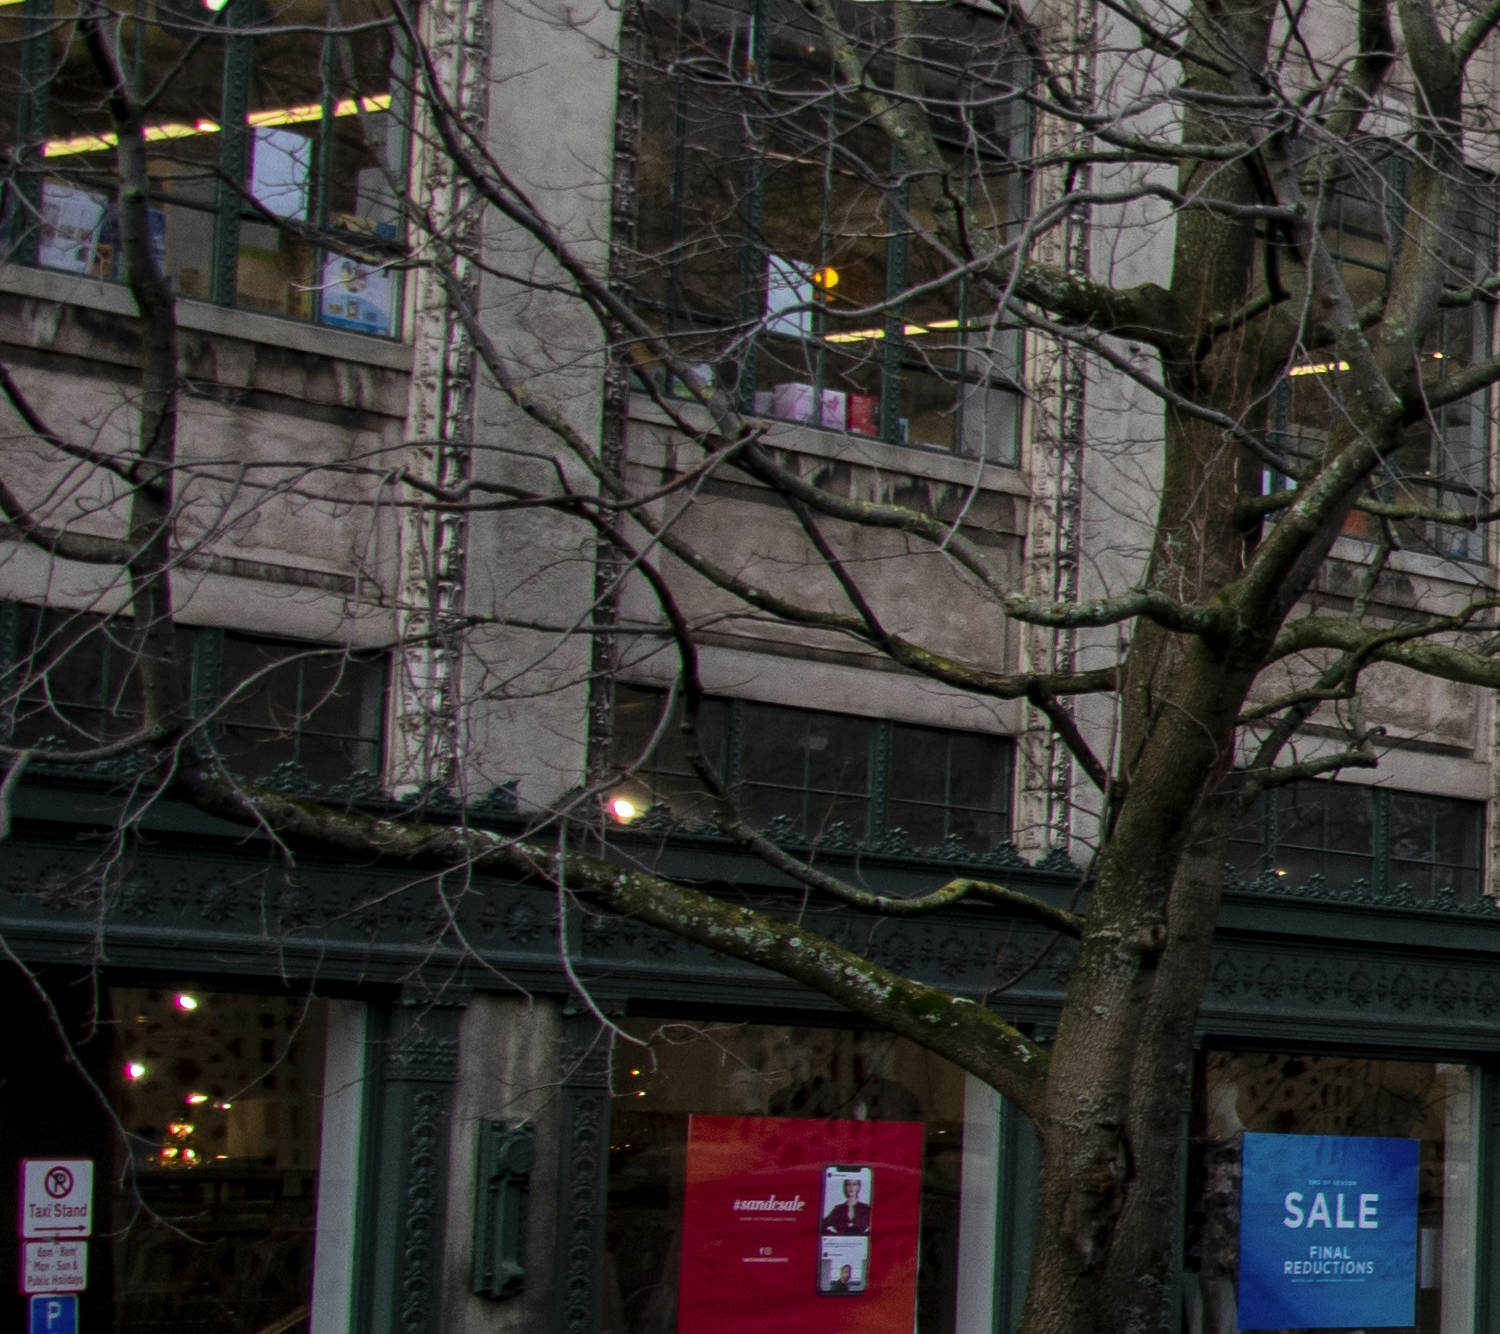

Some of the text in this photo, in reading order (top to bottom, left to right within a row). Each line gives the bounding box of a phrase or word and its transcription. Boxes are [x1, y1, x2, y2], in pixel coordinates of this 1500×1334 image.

[29, 1202, 87, 1218] Taxi Stand
[1282, 1192, 1379, 1228] SALE
[1309, 1246, 1351, 1259] FINAL
[1283, 1261, 1375, 1275] REDUCTIONS
[48, 1302, 61, 1329] P
